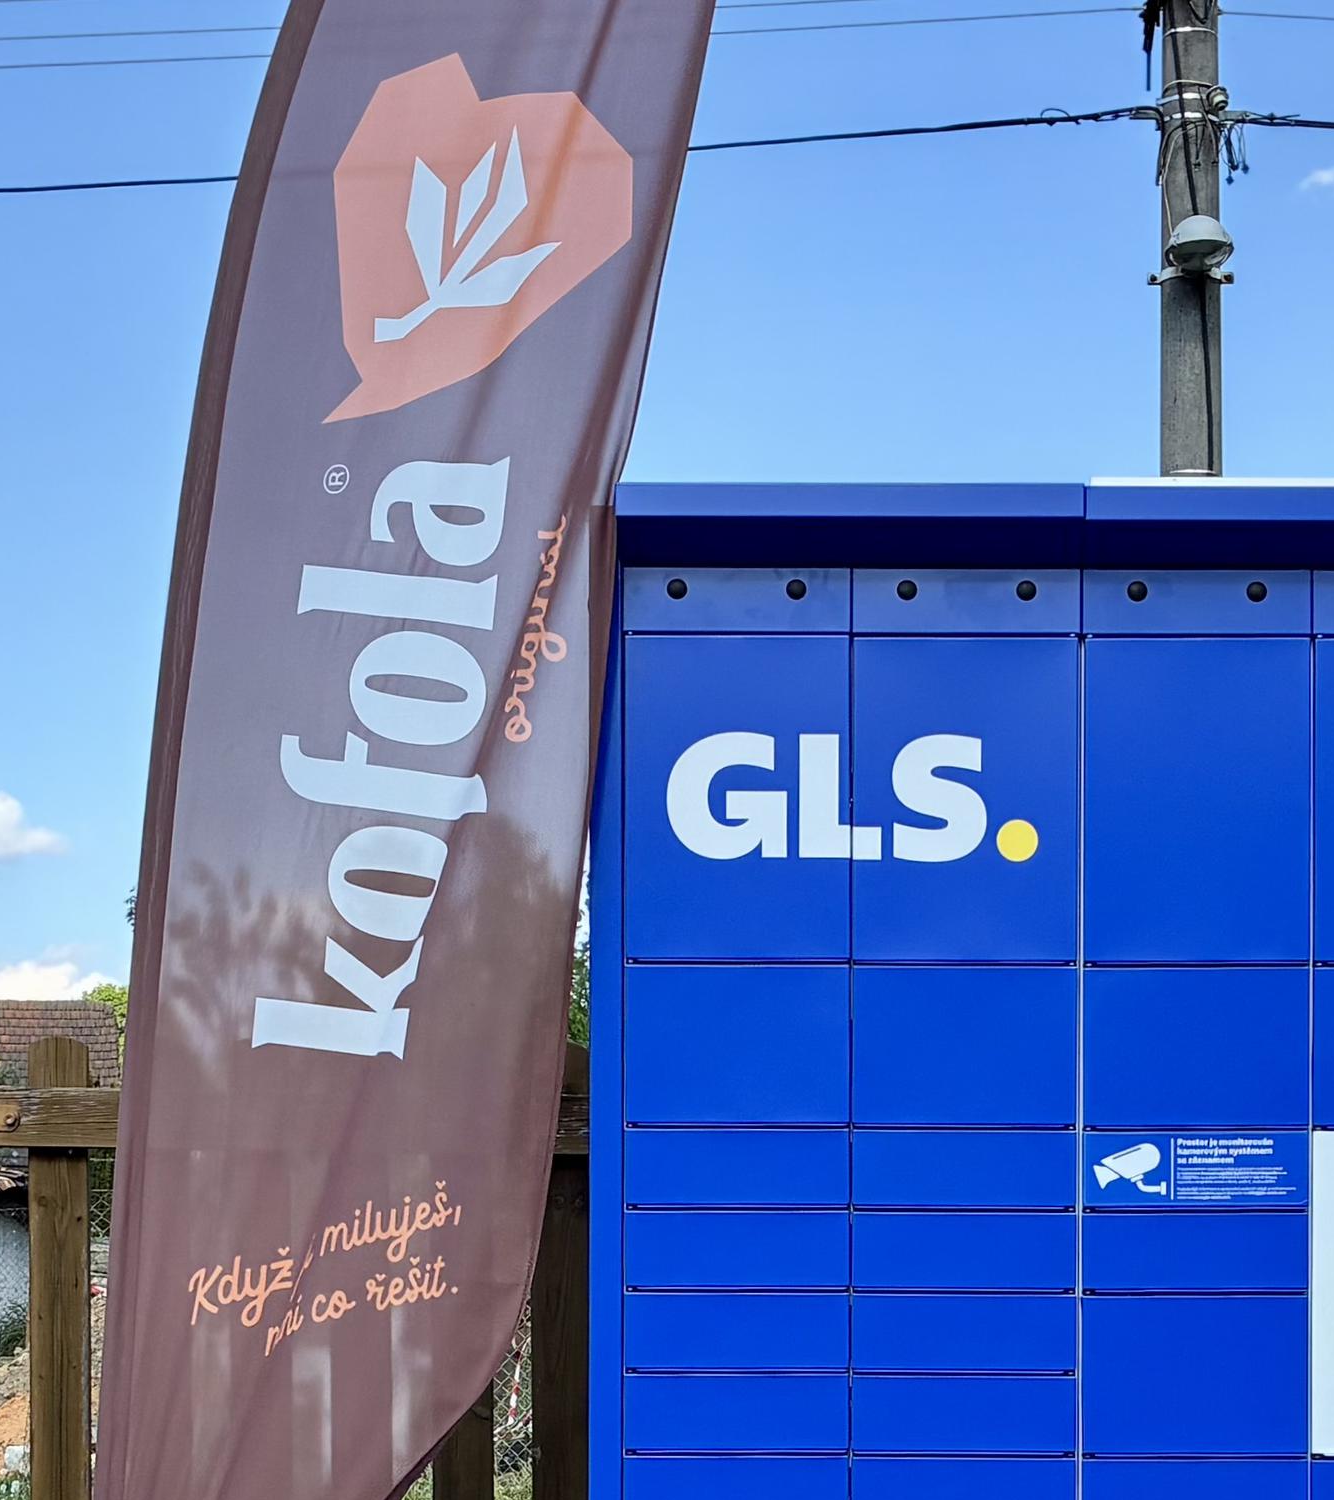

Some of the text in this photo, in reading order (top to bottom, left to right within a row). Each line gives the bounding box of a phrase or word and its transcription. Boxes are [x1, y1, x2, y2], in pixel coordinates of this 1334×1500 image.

[252, 455, 511, 1059] kofola
[188, 1246, 294, 1327] Když
[319, 1180, 461, 1262] miluješ,
[311, 1290, 356, 1323] co
[366, 1255, 459, 1311] řešit.
